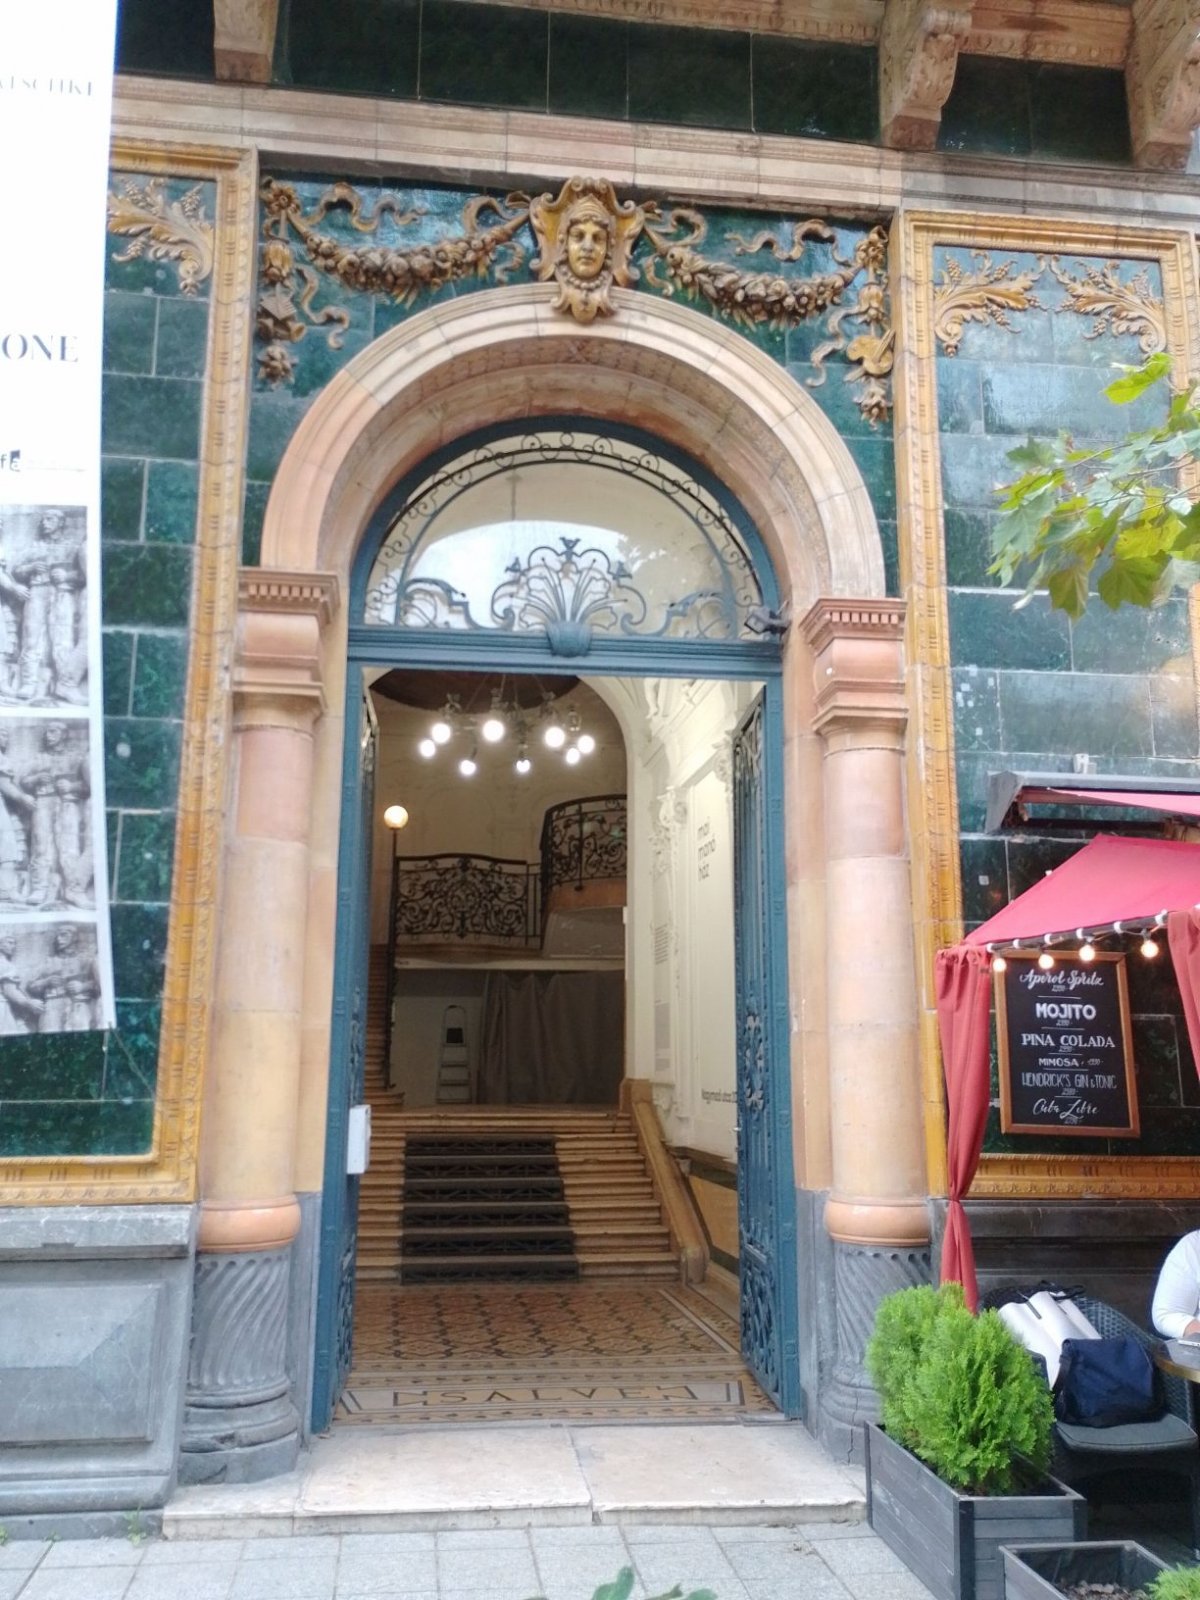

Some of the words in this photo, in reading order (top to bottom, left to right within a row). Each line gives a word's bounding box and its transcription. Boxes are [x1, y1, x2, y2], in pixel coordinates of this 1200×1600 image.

[1, 333, 79, 362] ONE
[1019, 969, 1066, 990] Aperol
[1067, 969, 1104, 991] Spritz
[1035, 1002, 1096, 1020] MOJITO
[1021, 1033, 1056, 1046] PINA
[1059, 1035, 1116, 1048] COLADA
[1038, 1058, 1079, 1067] MIMOSA
[1021, 1072, 1072, 1088] HENDRICK'S
[1074, 1074, 1089, 1089] GIN
[1032, 1098, 1060, 1116] Cuba
[1059, 1099, 1099, 1120] Libre
[440, 1386, 650, 1403] SALVE
